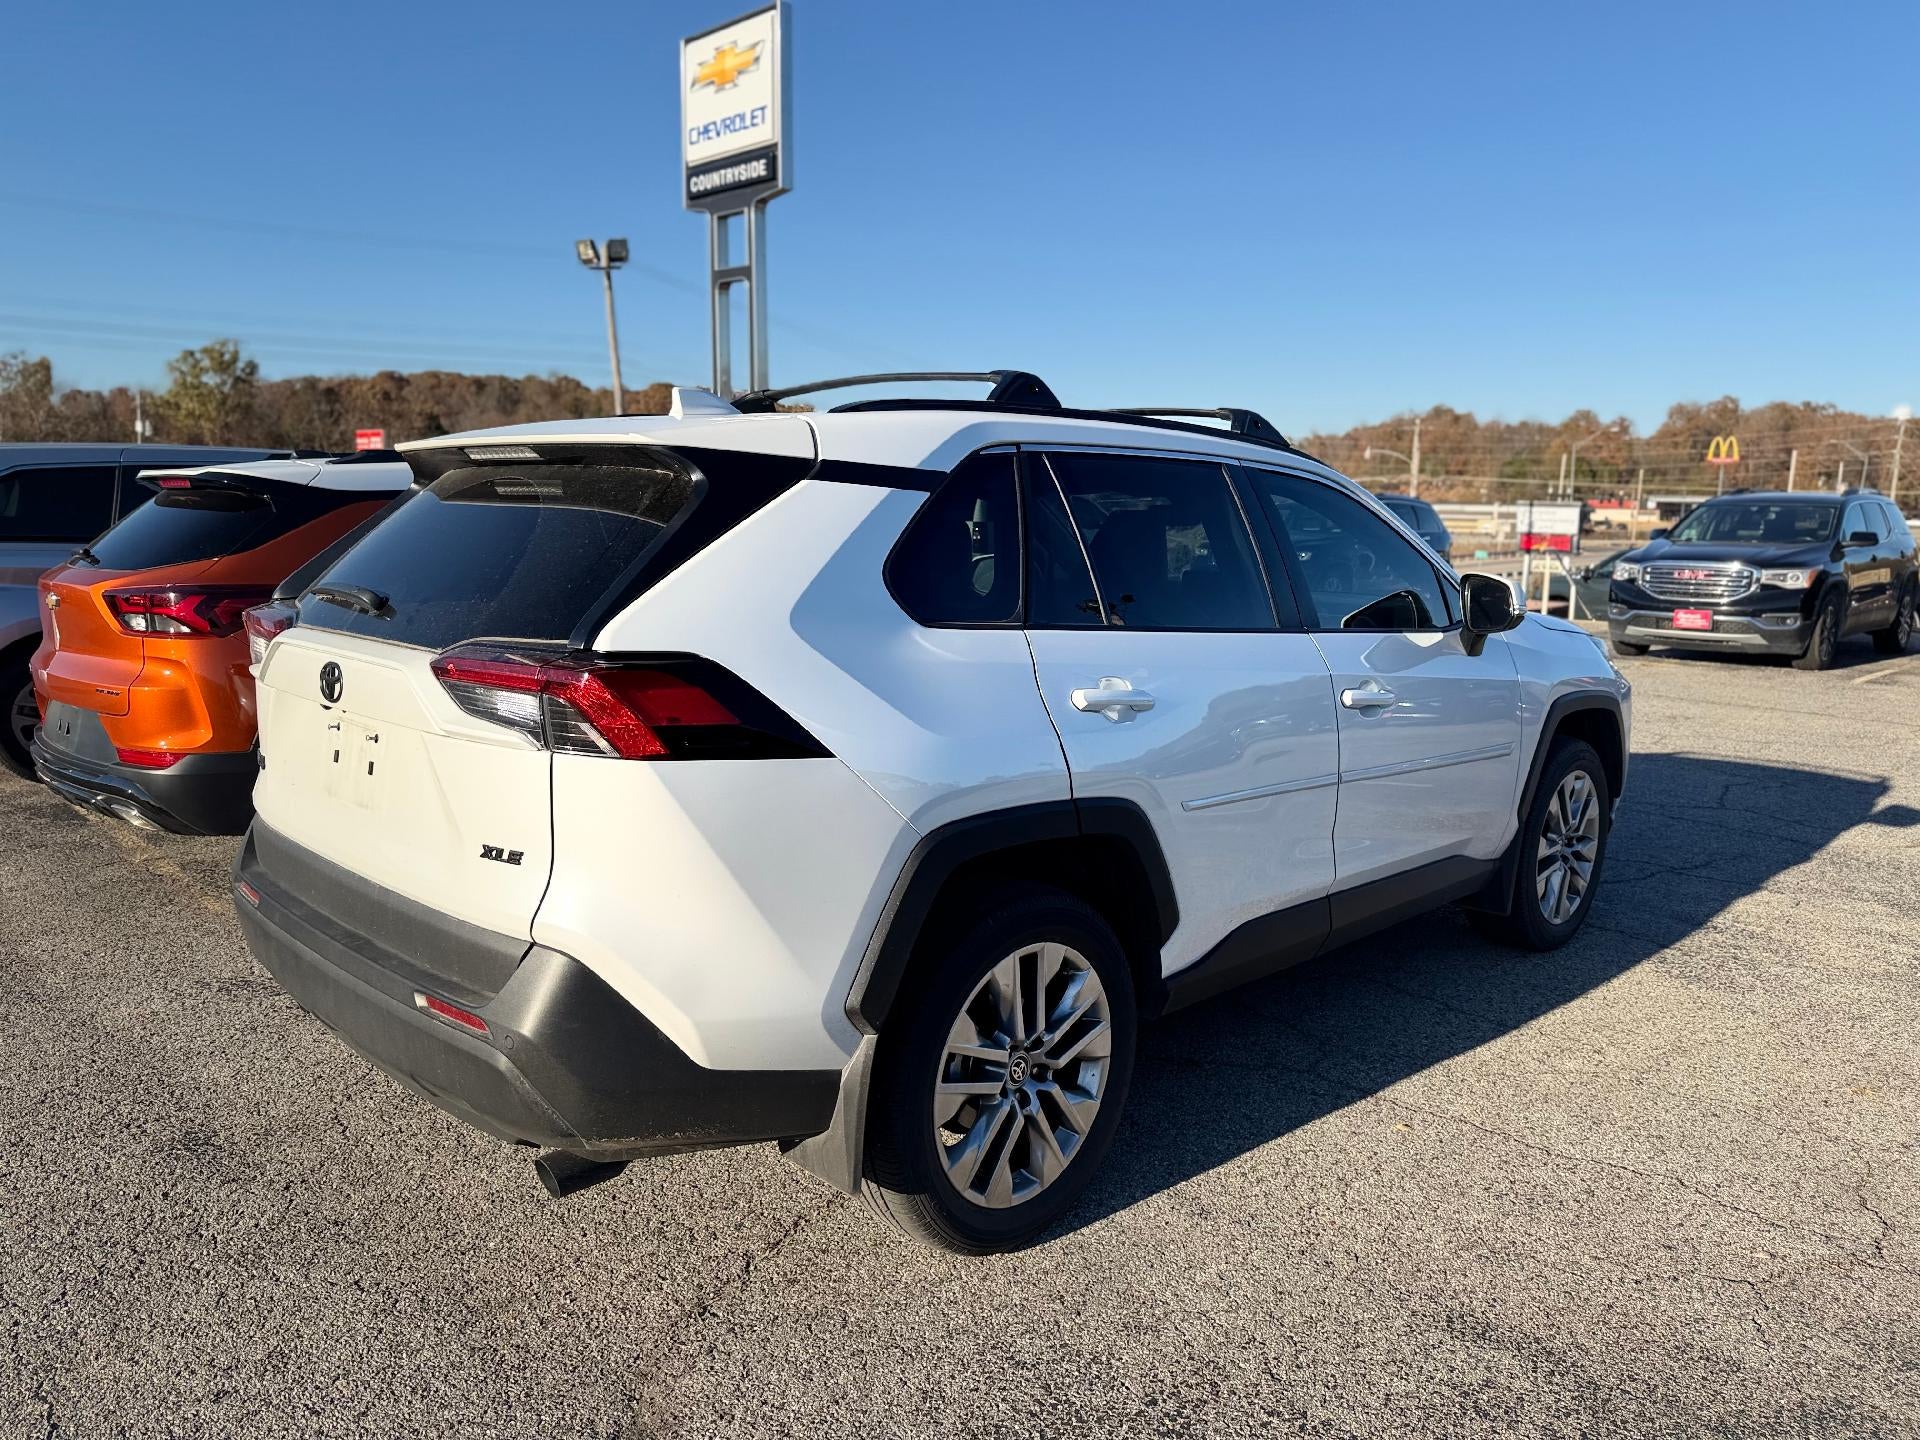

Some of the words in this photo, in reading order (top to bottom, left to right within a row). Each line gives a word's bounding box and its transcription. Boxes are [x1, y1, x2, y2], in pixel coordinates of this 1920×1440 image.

[689, 105, 768, 145] CHEVROLET
[689, 158, 768, 193] COUNTRYSIDE
[1673, 569, 1714, 580] GMC
[480, 844, 524, 866] XLE
